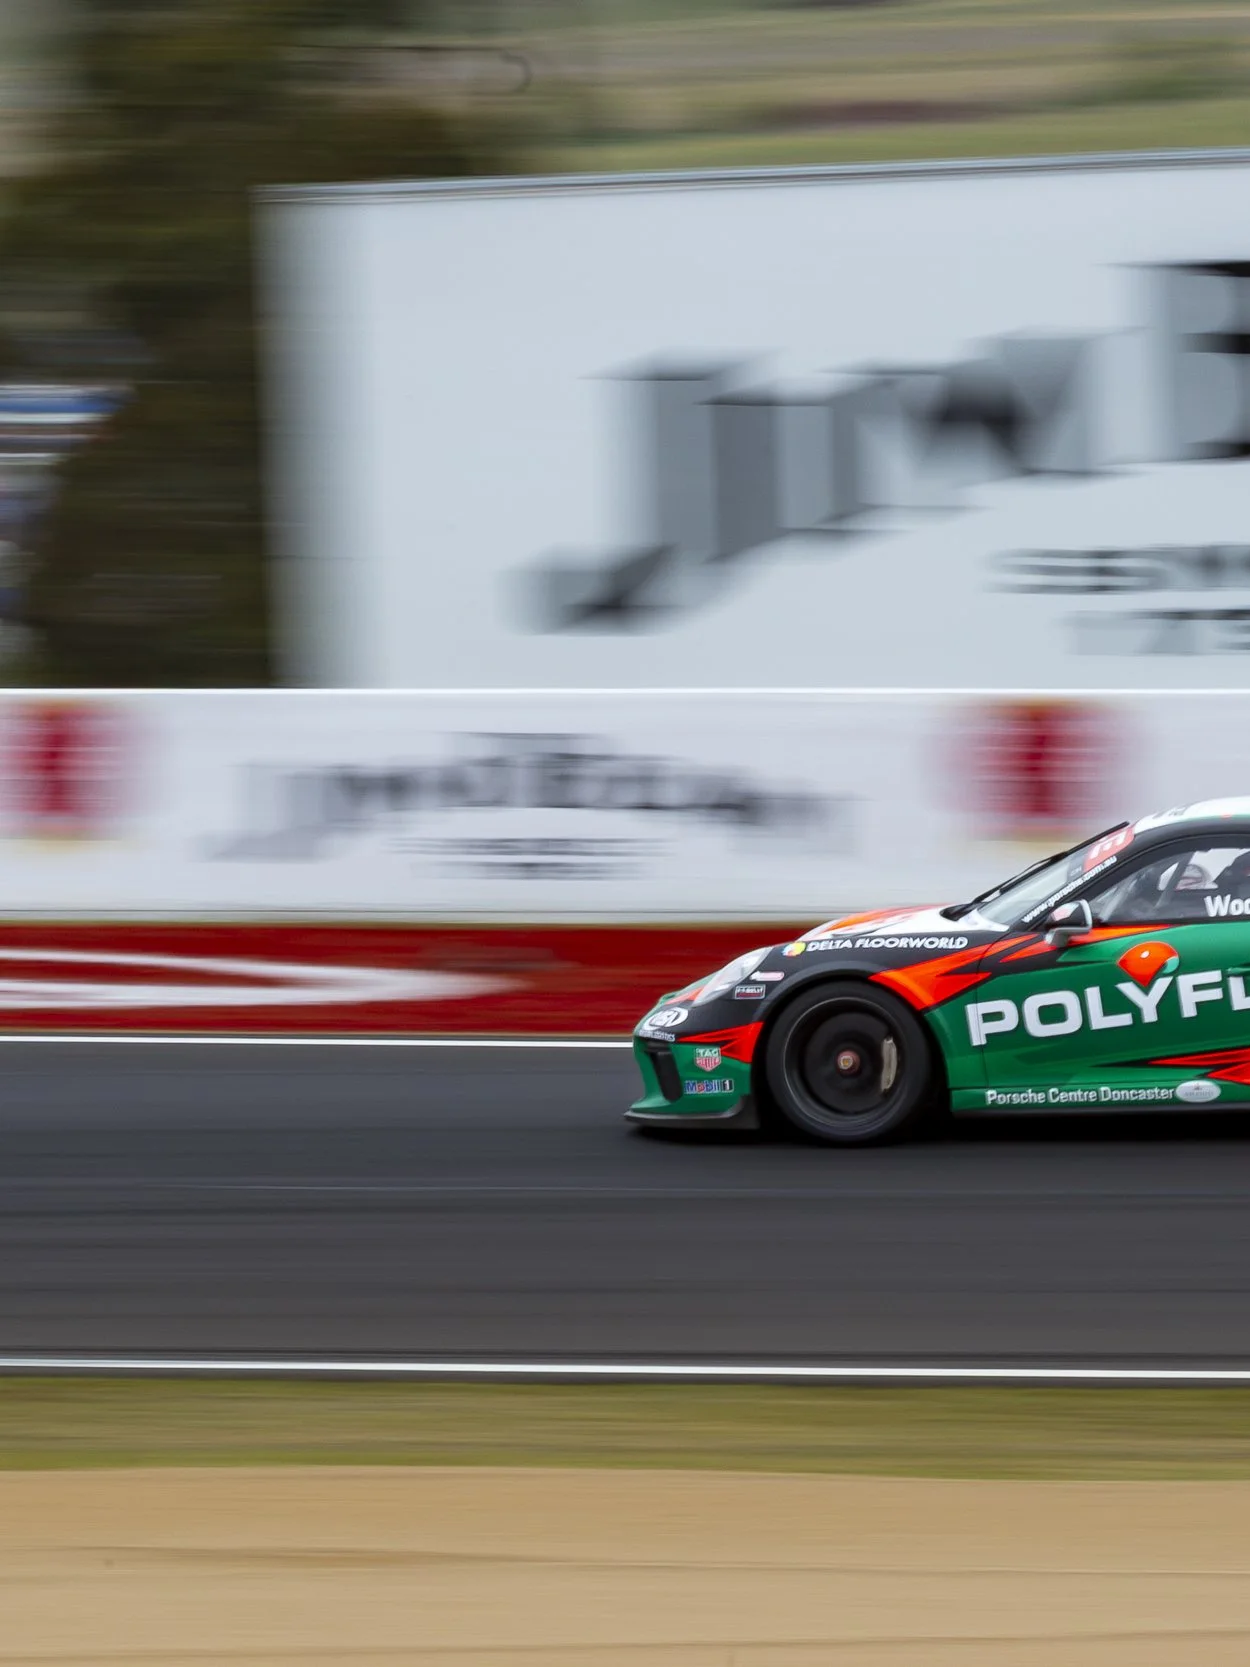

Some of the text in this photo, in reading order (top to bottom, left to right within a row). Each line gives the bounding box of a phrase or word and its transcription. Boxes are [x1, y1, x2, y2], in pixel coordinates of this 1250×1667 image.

[806, 936, 969, 952] DELTA FLOORWORLD
[698, 1048, 720, 1057] TAG
[684, 1080, 722, 1094] Mobil
[985, 1089, 1046, 1106] Porsche
[1048, 1087, 1098, 1104] Centre
[1099, 1085, 1175, 1103] Doncaster
